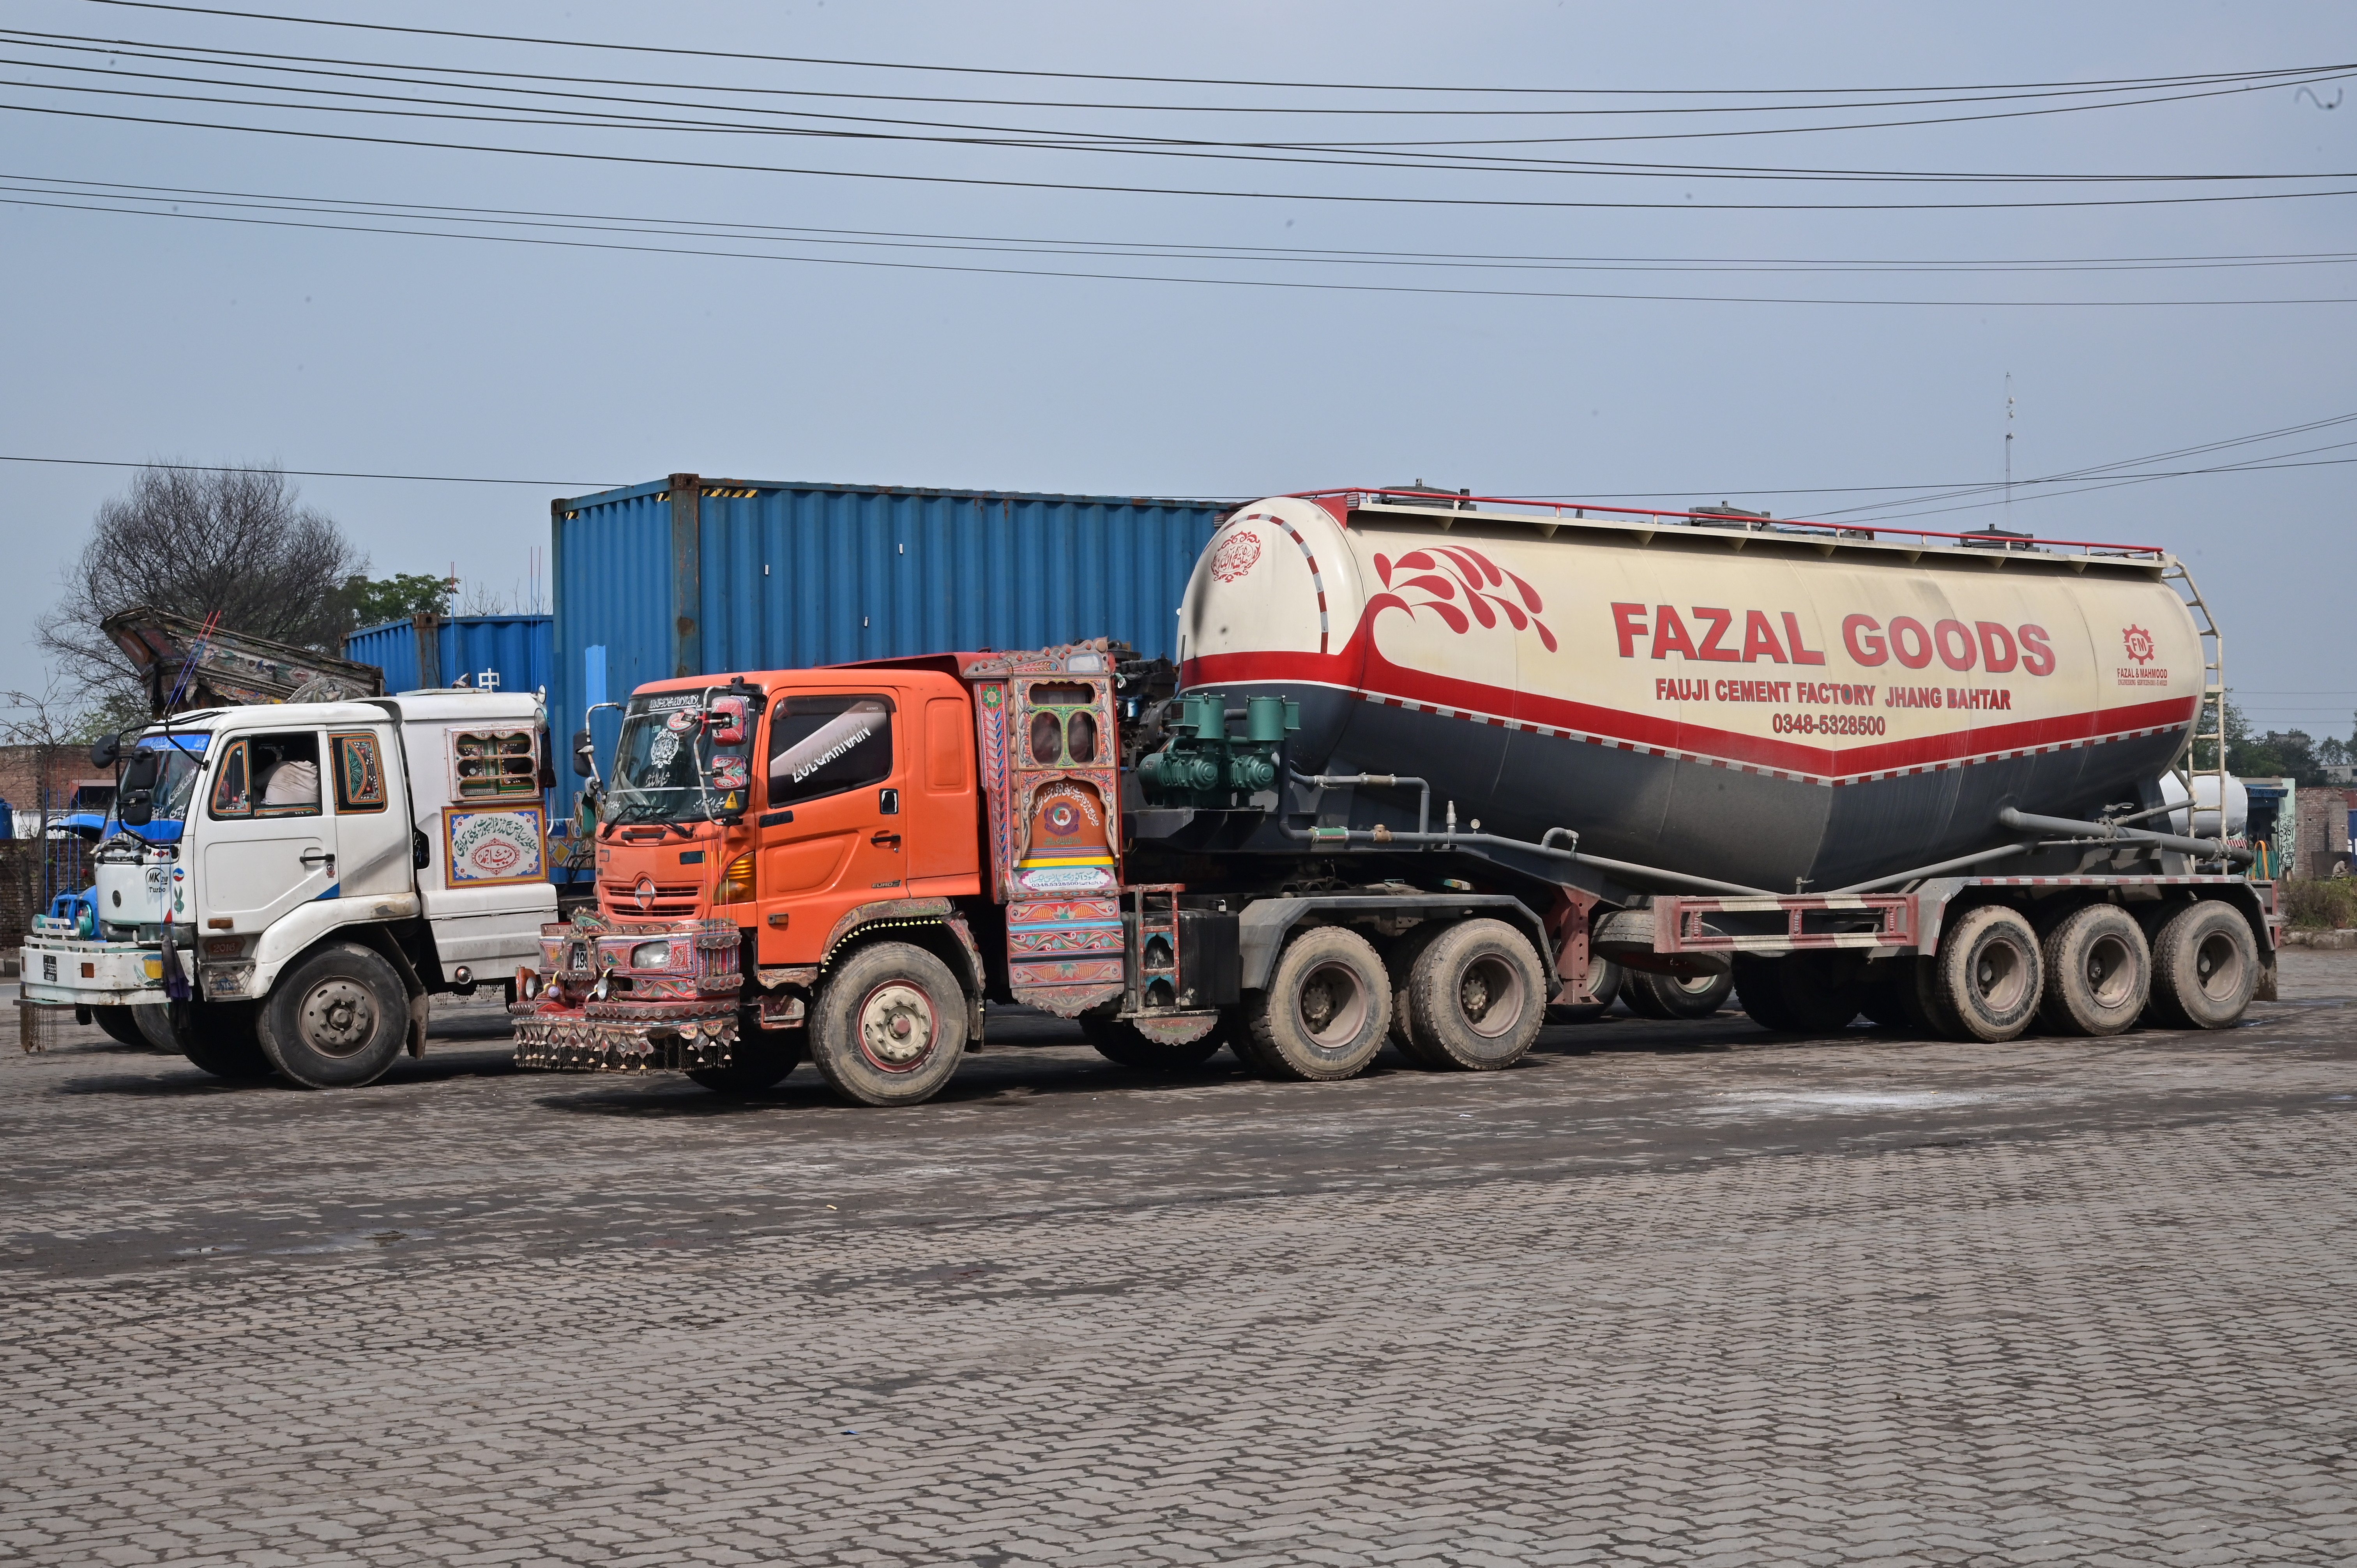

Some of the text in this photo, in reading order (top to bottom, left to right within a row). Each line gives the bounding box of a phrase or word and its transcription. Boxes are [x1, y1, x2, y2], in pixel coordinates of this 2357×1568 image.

[1610, 602, 2056, 676] FAZAL GOODS
[2131, 637, 2147, 652] FM
[2117, 668, 2168, 679] FAZAL & MAHMOOD
[1656, 678, 2011, 710] FAUJI CEMENT FACTORY JHANG BAHTAR
[1772, 713, 1886, 736] 0348-5328500
[148, 872, 161, 883] MK
[213, 943, 235, 952] 2016
